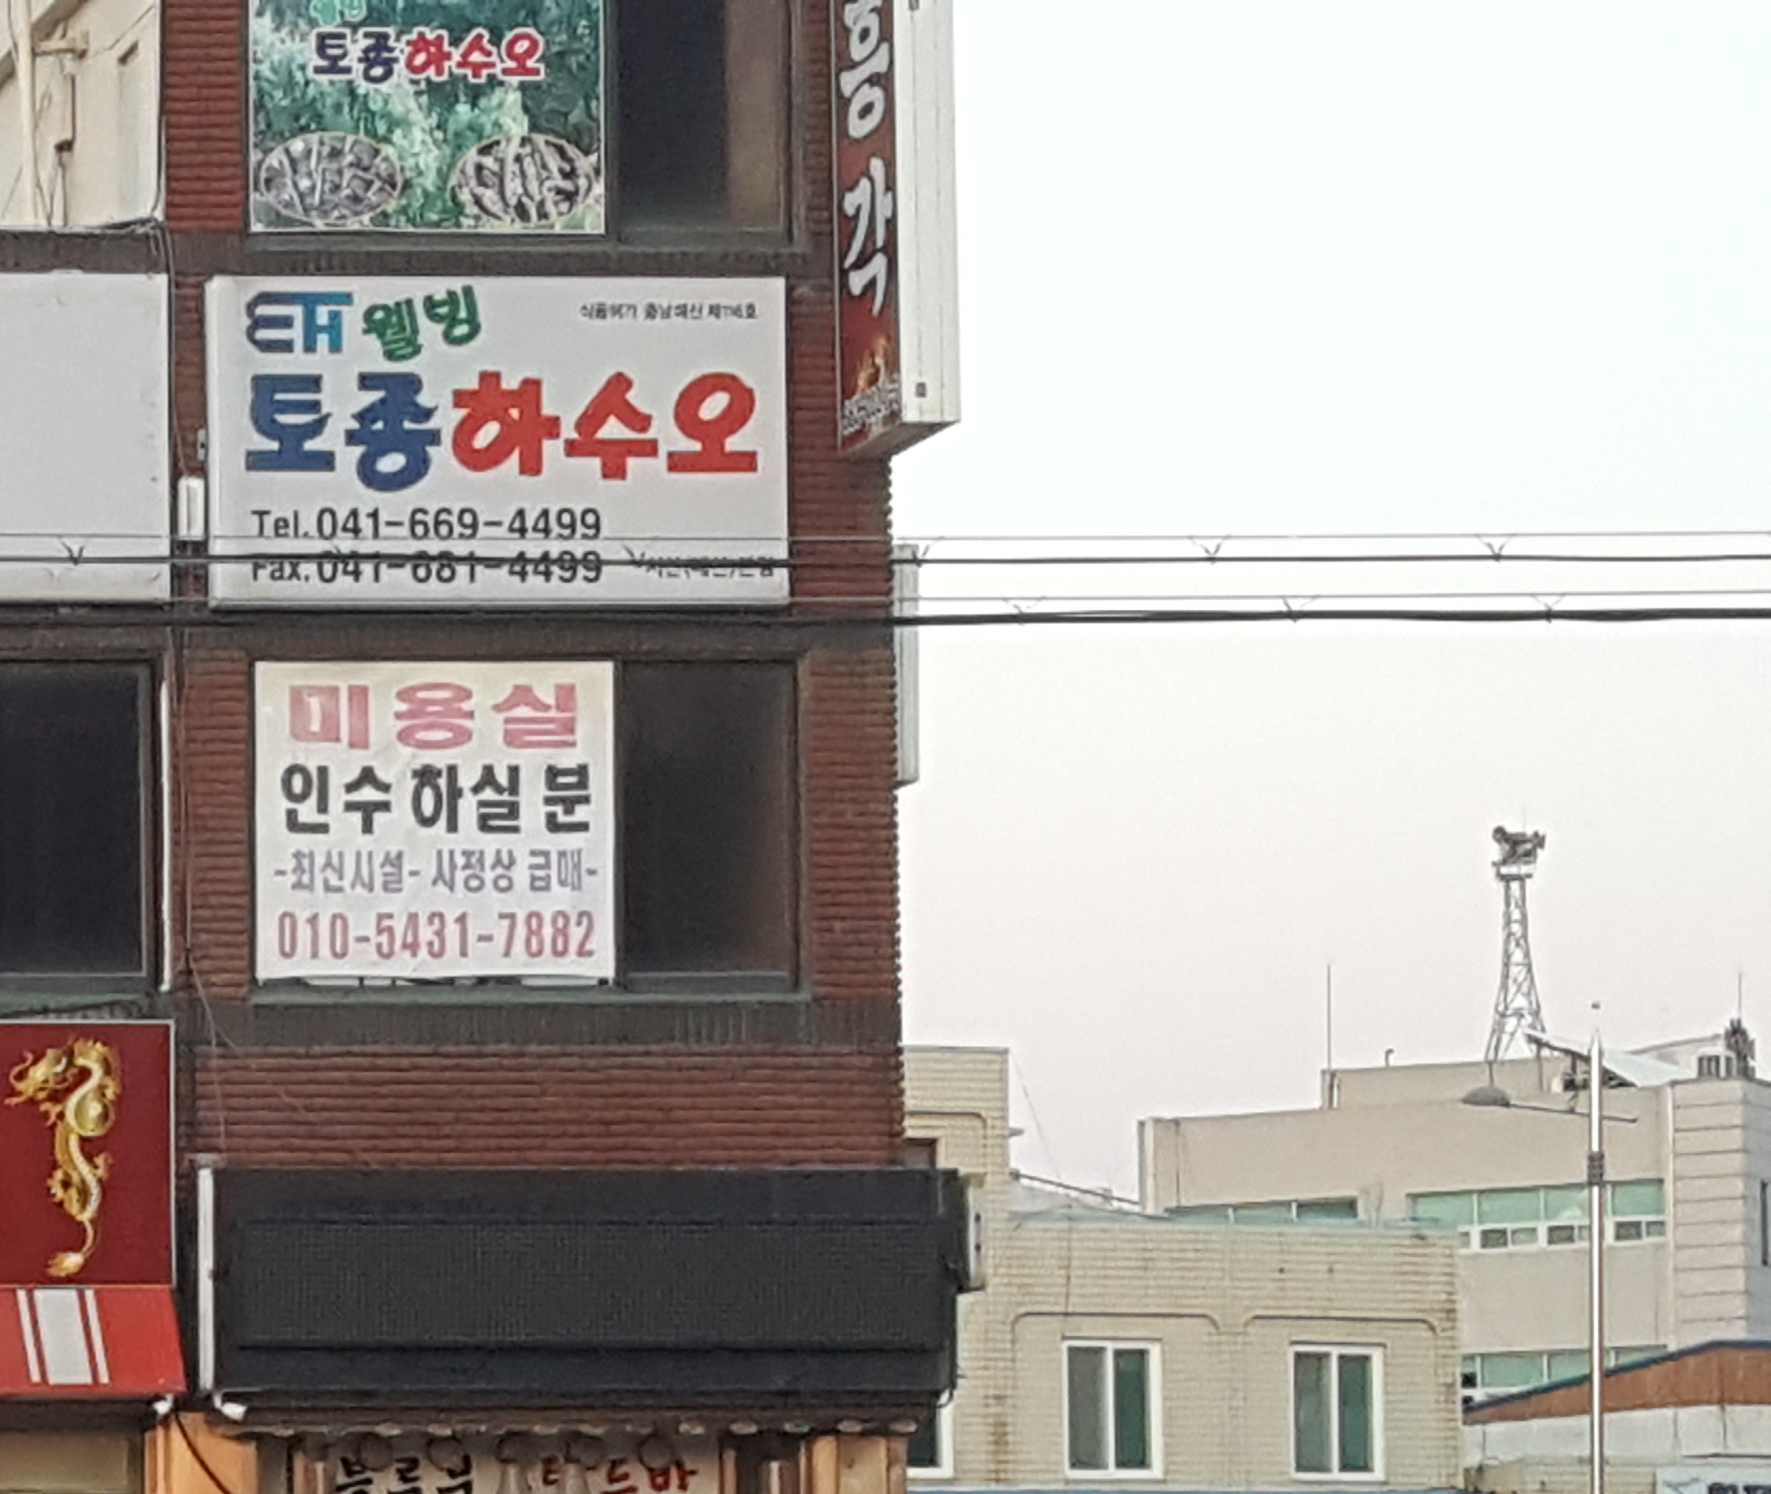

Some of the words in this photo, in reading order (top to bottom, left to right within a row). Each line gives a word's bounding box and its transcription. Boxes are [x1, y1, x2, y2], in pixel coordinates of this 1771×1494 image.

[311, 28, 545, 85] 토종하수오
[362, 284, 482, 362] 웰빙
[245, 369, 759, 493] 토종하수오
[289, 681, 579, 751] 미용실
[429, 847, 517, 895] 사정상
[277, 910, 597, 963] 010-5431-7882
